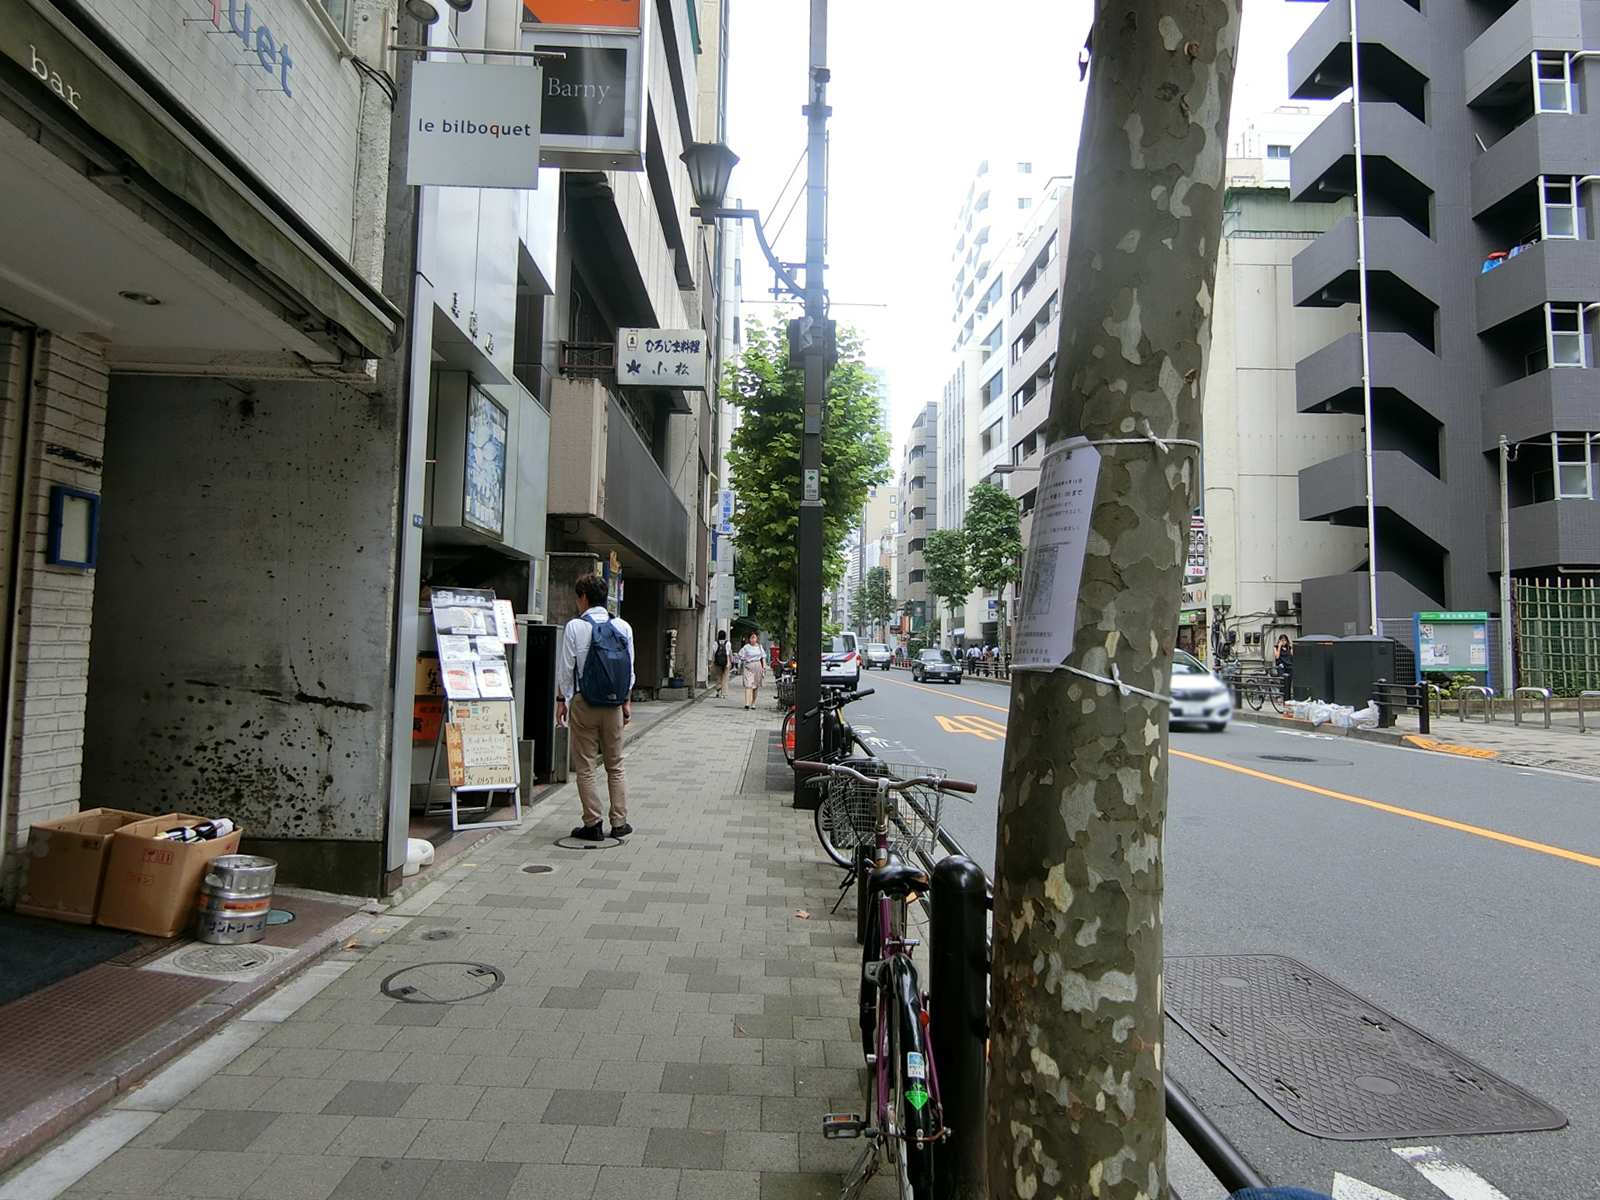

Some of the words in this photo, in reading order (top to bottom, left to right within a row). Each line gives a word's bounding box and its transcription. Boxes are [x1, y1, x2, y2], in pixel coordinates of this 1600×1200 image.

[208, 0, 293, 99] uet
[29, 44, 82, 111] bar
[547, 76, 611, 104] Barny
[418, 118, 435, 132] le
[442, 119, 531, 138] bilboquet
[645, 339, 701, 354] ひろじま料理
[652, 360, 690, 376] 小松
